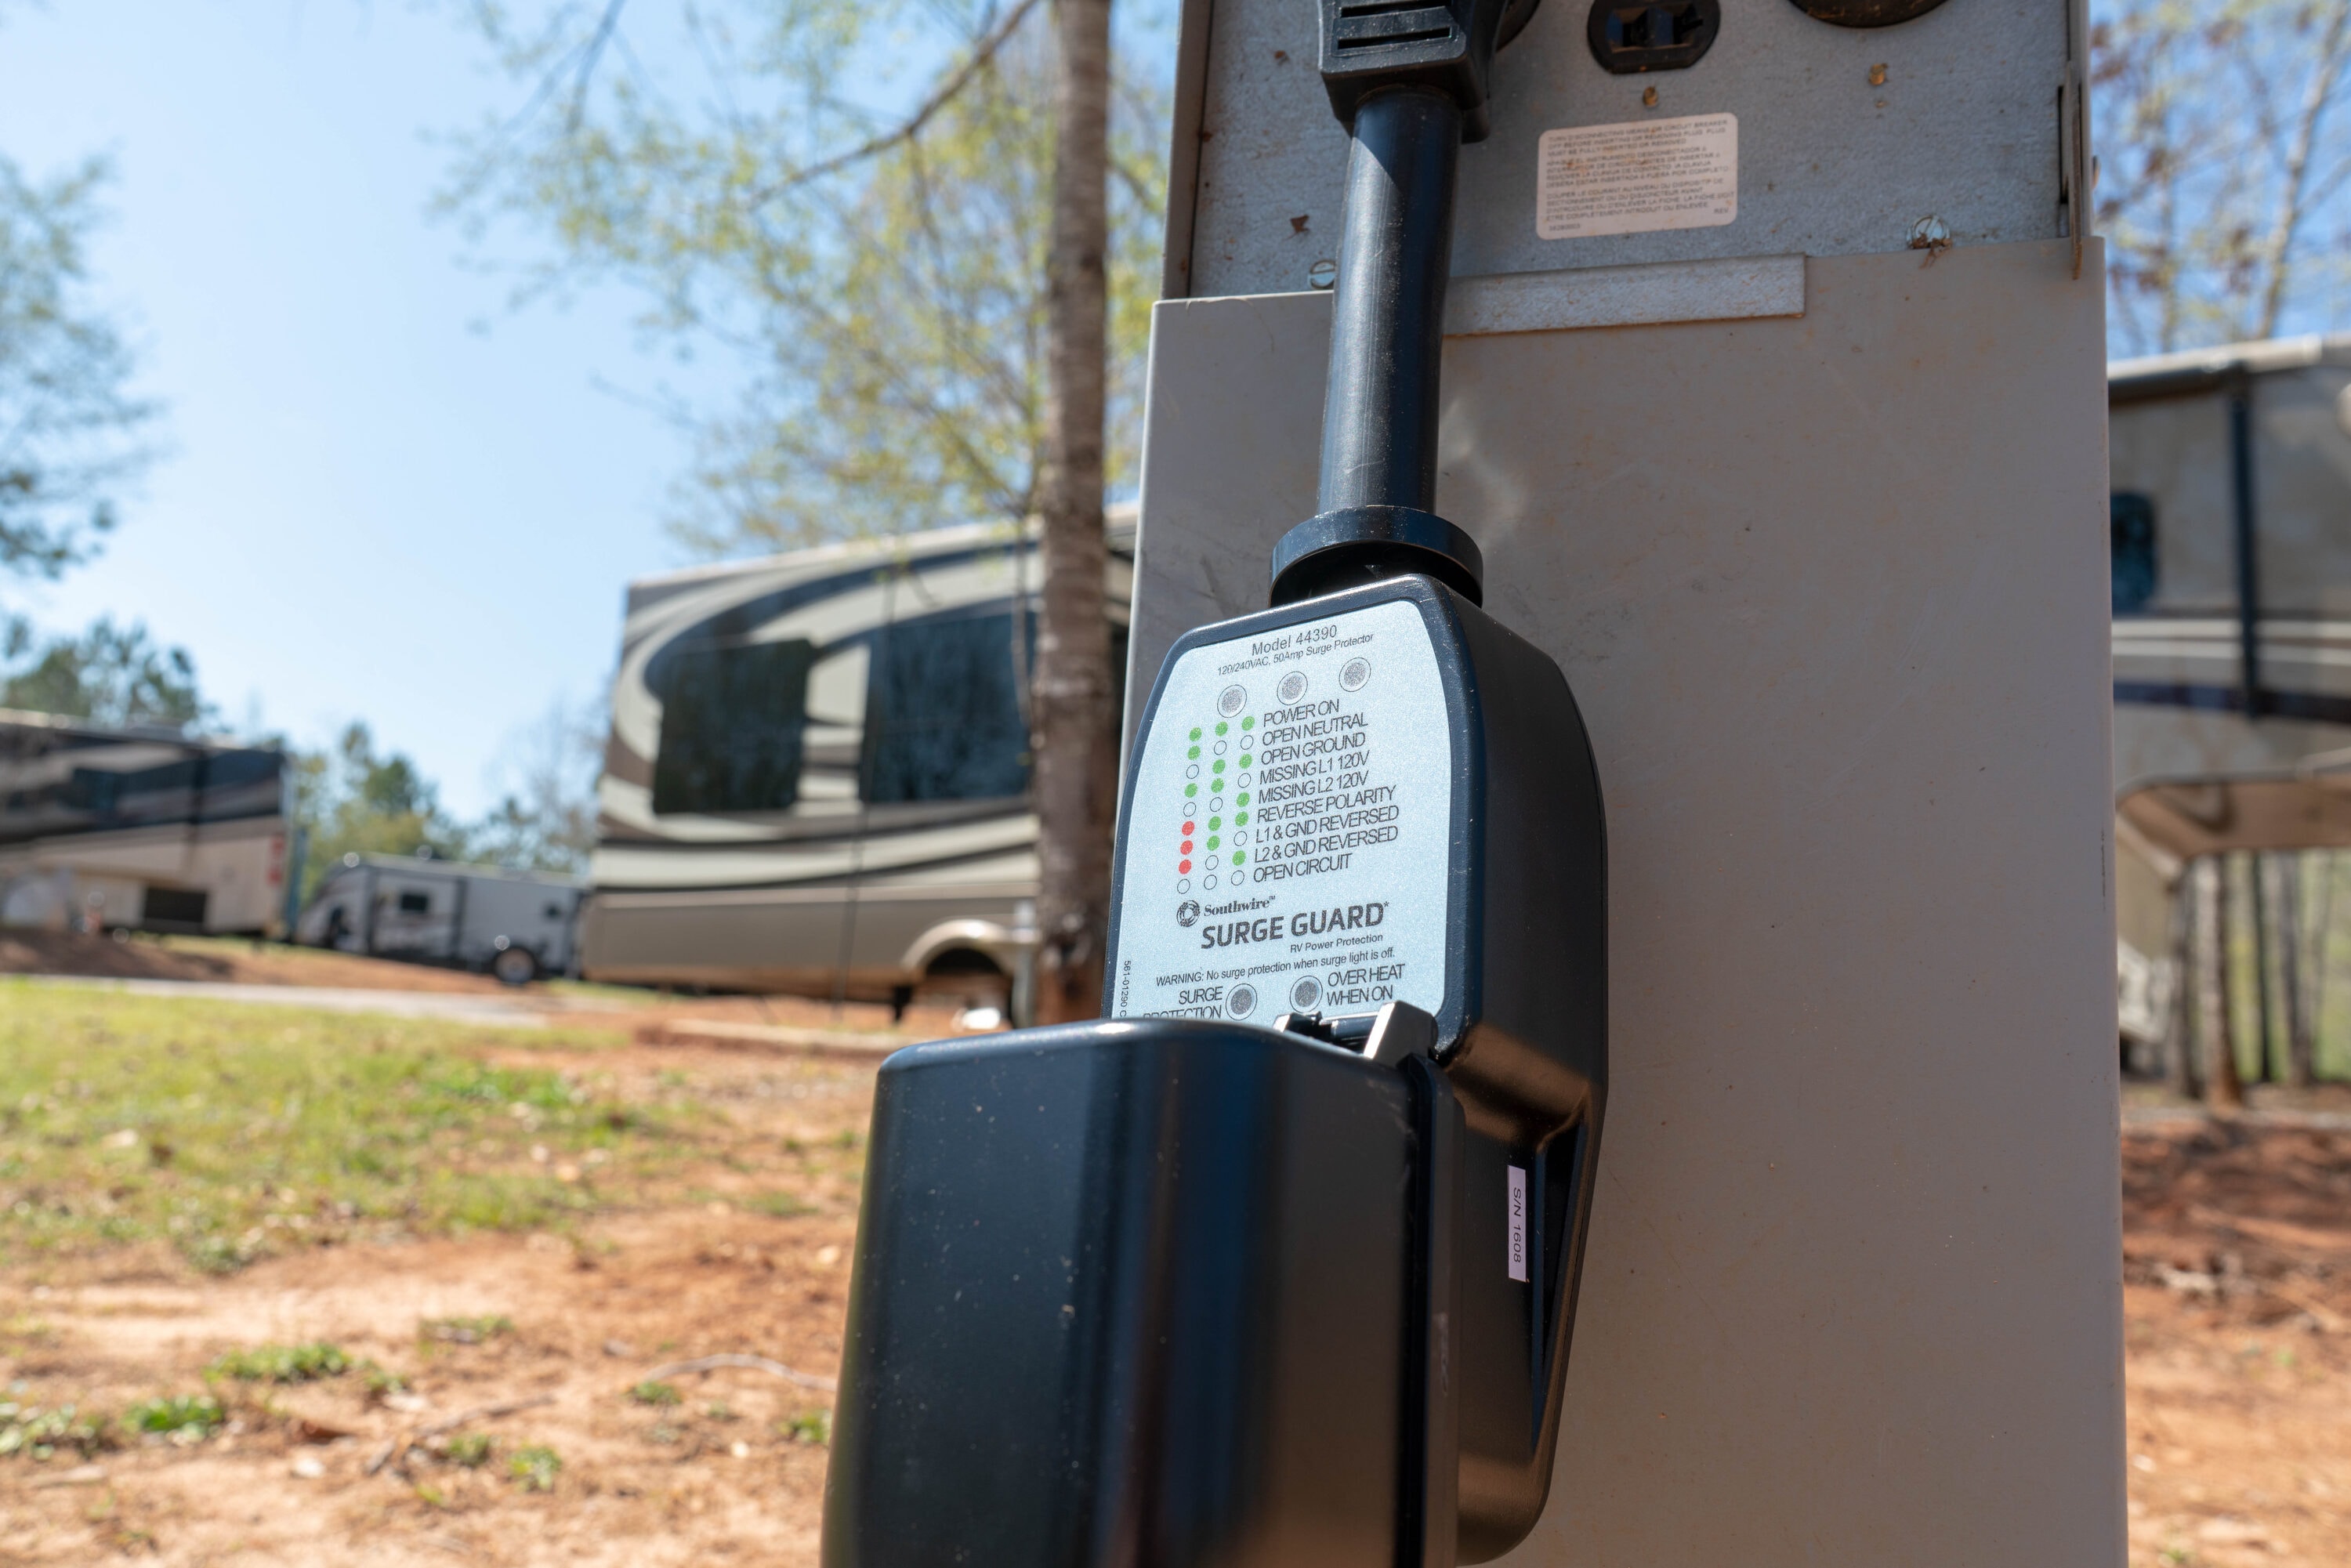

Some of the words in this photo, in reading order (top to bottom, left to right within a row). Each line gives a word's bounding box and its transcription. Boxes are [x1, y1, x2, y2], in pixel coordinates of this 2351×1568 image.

[1217, 657, 1270, 675] 120/240VAC,
[1273, 650, 1304, 664] 50Amp
[1306, 643, 1331, 656] Surge
[1334, 633, 1374, 650] Protector
[1252, 635, 1291, 656] Model
[1296, 625, 1337, 645] 44390
[1262, 725, 1301, 745] OPEN
[1303, 712, 1368, 738] NEUTRAL
[1263, 704, 1316, 727] POWER
[1318, 698, 1339, 715] ON
[1261, 744, 1300, 765] OPEN
[1302, 732, 1366, 757] GROUND
[1259, 760, 1317, 784] MISSING
[1318, 757, 1332, 773] L1
[1338, 750, 1370, 770] 120V
[1259, 780, 1315, 804] MISSING
[1317, 777, 1333, 793] L2
[1337, 770, 1369, 790] 120V
[1257, 798, 1324, 824] REVERSE
[1325, 784, 1396, 812] POLARITY
[1255, 827, 1270, 843] L1
[1273, 824, 1283, 841] &
[1285, 819, 1317, 838] GND
[1319, 805, 1400, 833] REVERSED
[1255, 846, 1270, 863] L2
[1272, 845, 1281, 860] &
[1284, 839, 1317, 858] GND
[1318, 825, 1399, 853] REVERSED
[1253, 862, 1293, 882] OPEN
[1295, 853, 1353, 877] CIRCUIT
[1201, 916, 1284, 950] SURGE
[1290, 943, 1302, 954] RV
[1305, 941, 1332, 951] Power
[1336, 934, 1383, 947] Protection
[1156, 972, 1204, 987] WARNING:
[1206, 970, 1219, 980] No
[1221, 968, 1245, 980] surge
[1248, 961, 1291, 977] protection
[1293, 958, 1318, 970] when
[1320, 956, 1346, 967] surge
[1349, 951, 1368, 965] light
[1371, 951, 1378, 960] is
[1381, 947, 1395, 958] off.
[1328, 969, 1367, 987] OVER
[1369, 964, 1405, 983] HEAT
[1120, 961, 1131, 1008] 561-01290
[1179, 986, 1223, 1005] SURGE
[1327, 987, 1369, 1007] WHEN
[1371, 985, 1393, 1001] ON
